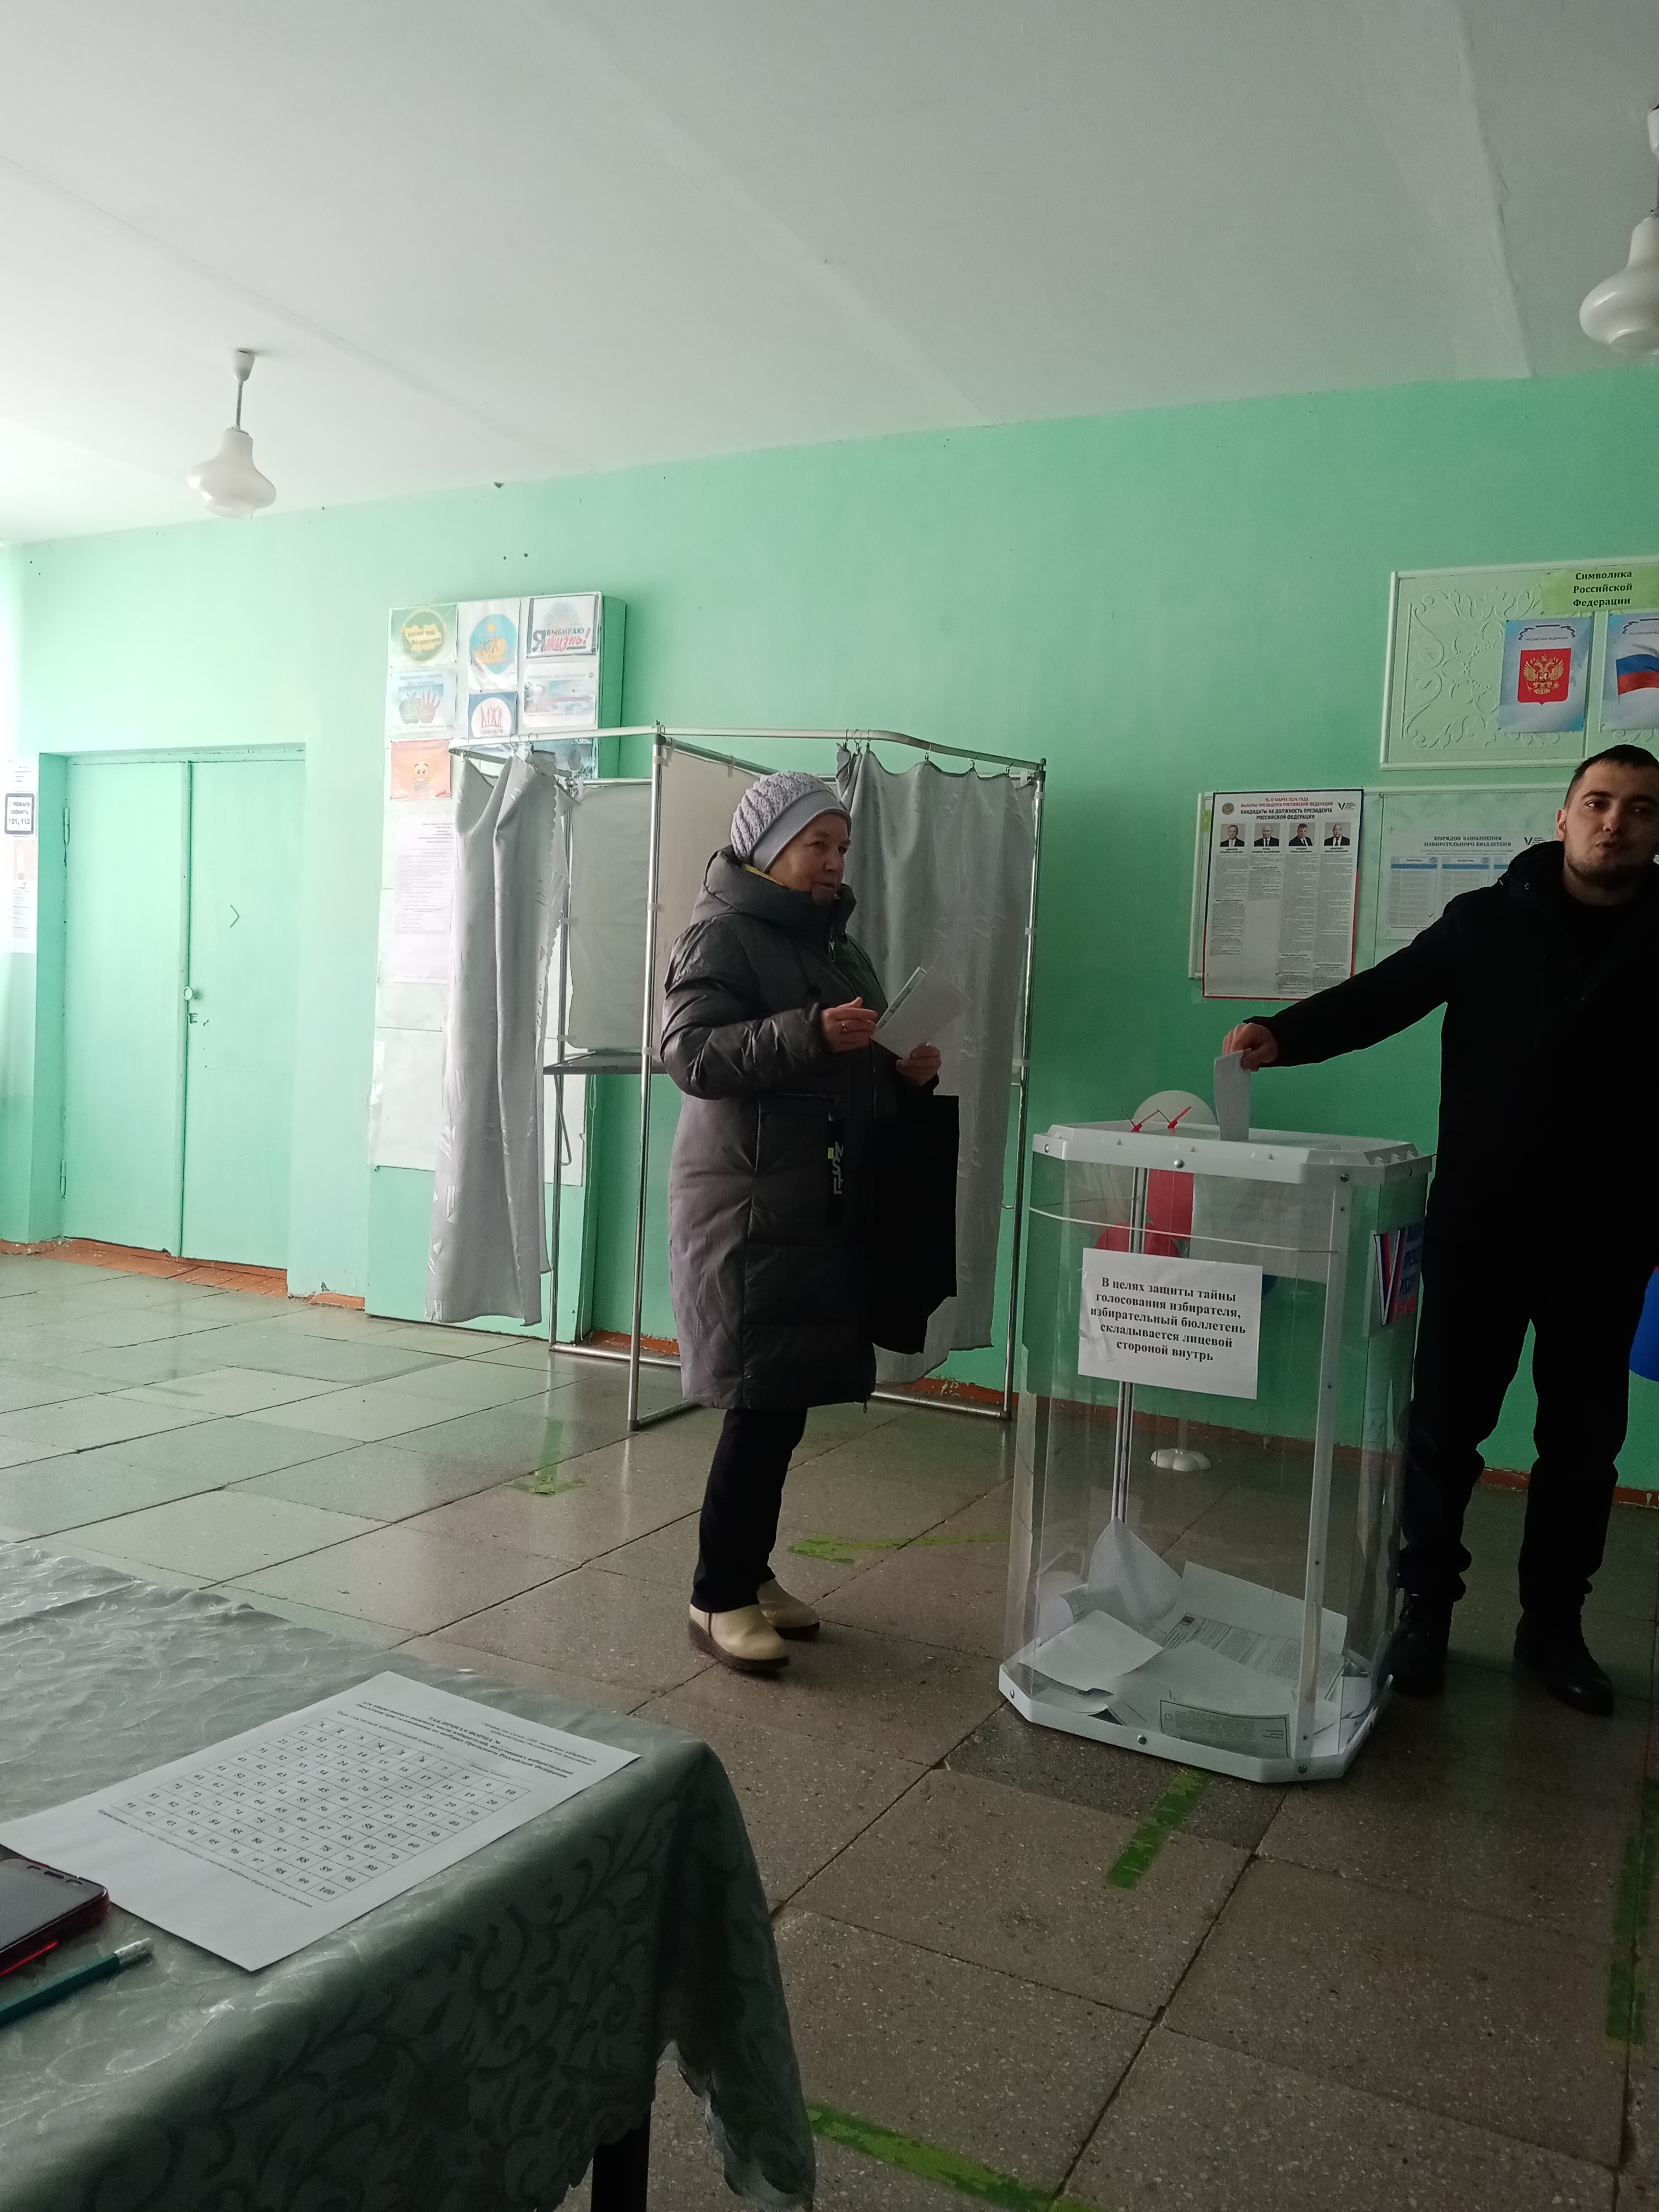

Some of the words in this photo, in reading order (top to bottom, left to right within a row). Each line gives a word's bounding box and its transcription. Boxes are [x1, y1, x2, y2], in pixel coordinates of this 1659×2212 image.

[1576, 572, 1632, 580] Символика
[1573, 583, 1632, 593] Российской
[1573, 598, 1630, 608] Федерации
[547, 627, 584, 636] ВЫБИРАЮ
[1102, 1277, 1109, 1287] В
[1113, 1281, 1144, 1292] целях
[1148, 1285, 1193, 1297] защиты
[1197, 1289, 1236, 1302] тайны
[1096, 1294, 1166, 1309] голосования
[1170, 1302, 1241, 1319] избирателя,
[1091, 1308, 1177, 1326] избирательный
[1181, 1317, 1246, 1334] бюллетень
[1100, 1324, 1179, 1341] складывается
[1182, 1335, 1232, 1347] лицевой
[1117, 1341, 1168, 1355] стороной
[1172, 1348, 1213, 1362] внутрь
